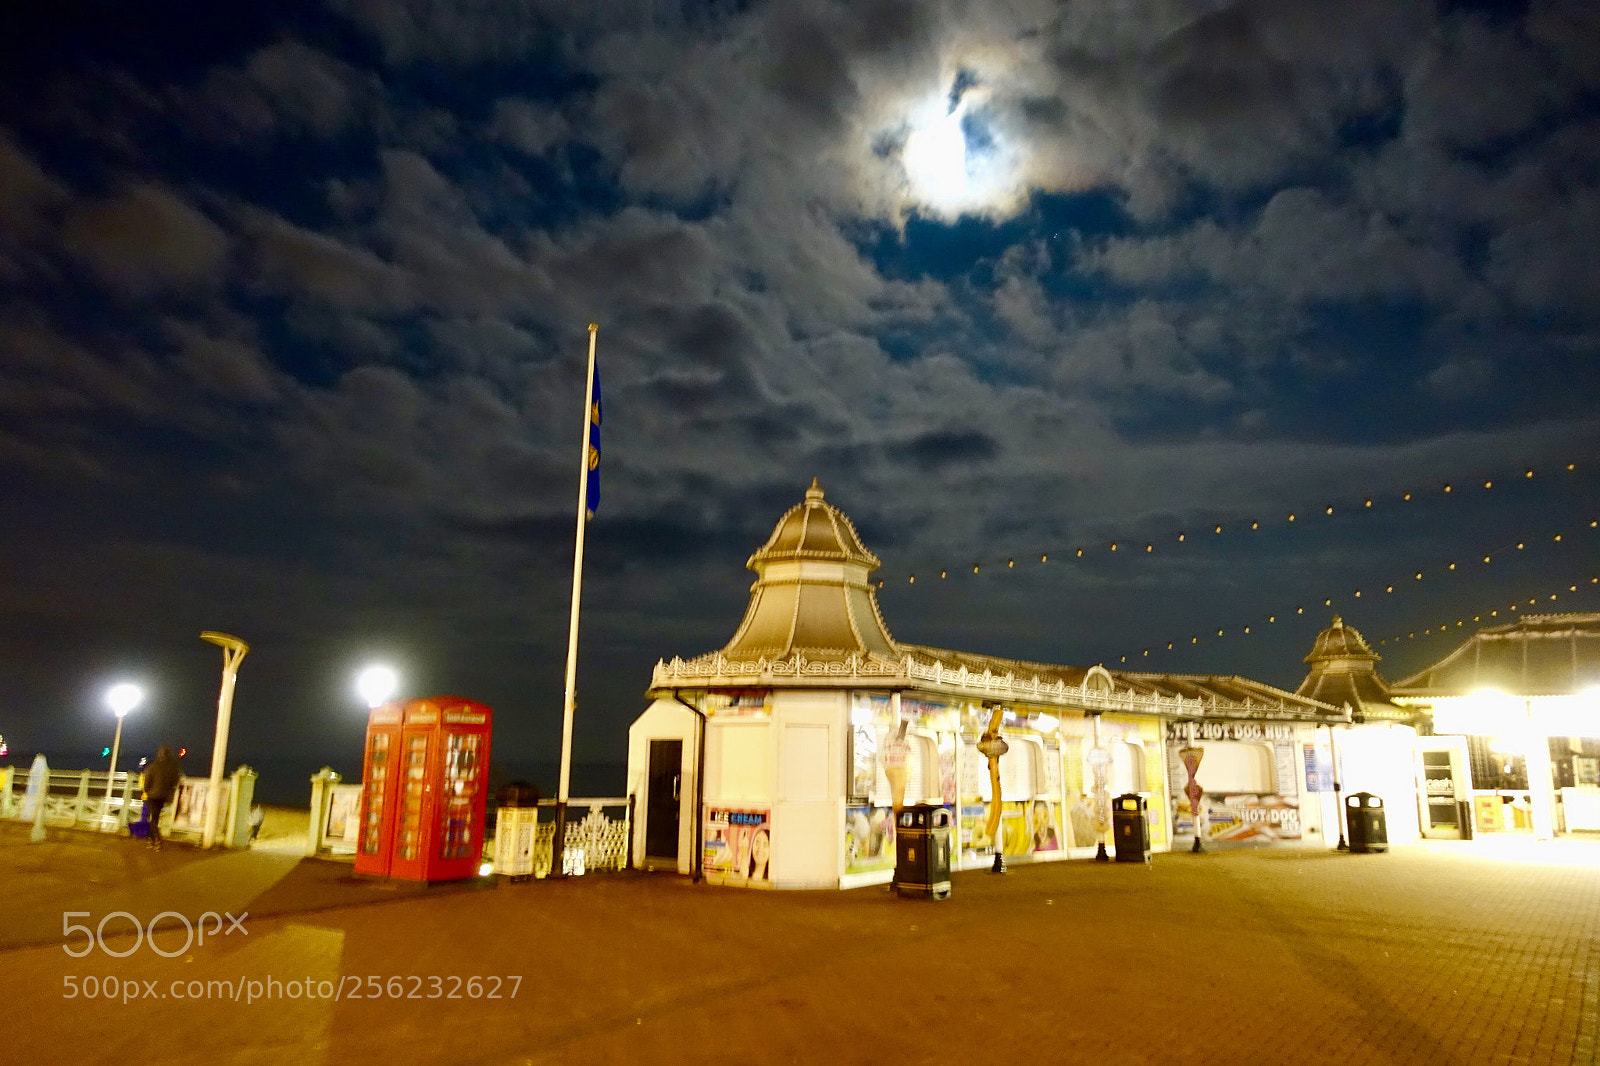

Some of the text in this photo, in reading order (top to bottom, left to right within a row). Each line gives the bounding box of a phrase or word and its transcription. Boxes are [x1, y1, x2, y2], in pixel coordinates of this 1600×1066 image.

[1203, 721, 1231, 739] HOT
[1234, 722, 1263, 740] DOG
[1264, 722, 1291, 740] HUT
[714, 811, 763, 826] ICE CREAM
[1240, 808, 1298, 824] HOT DOG
